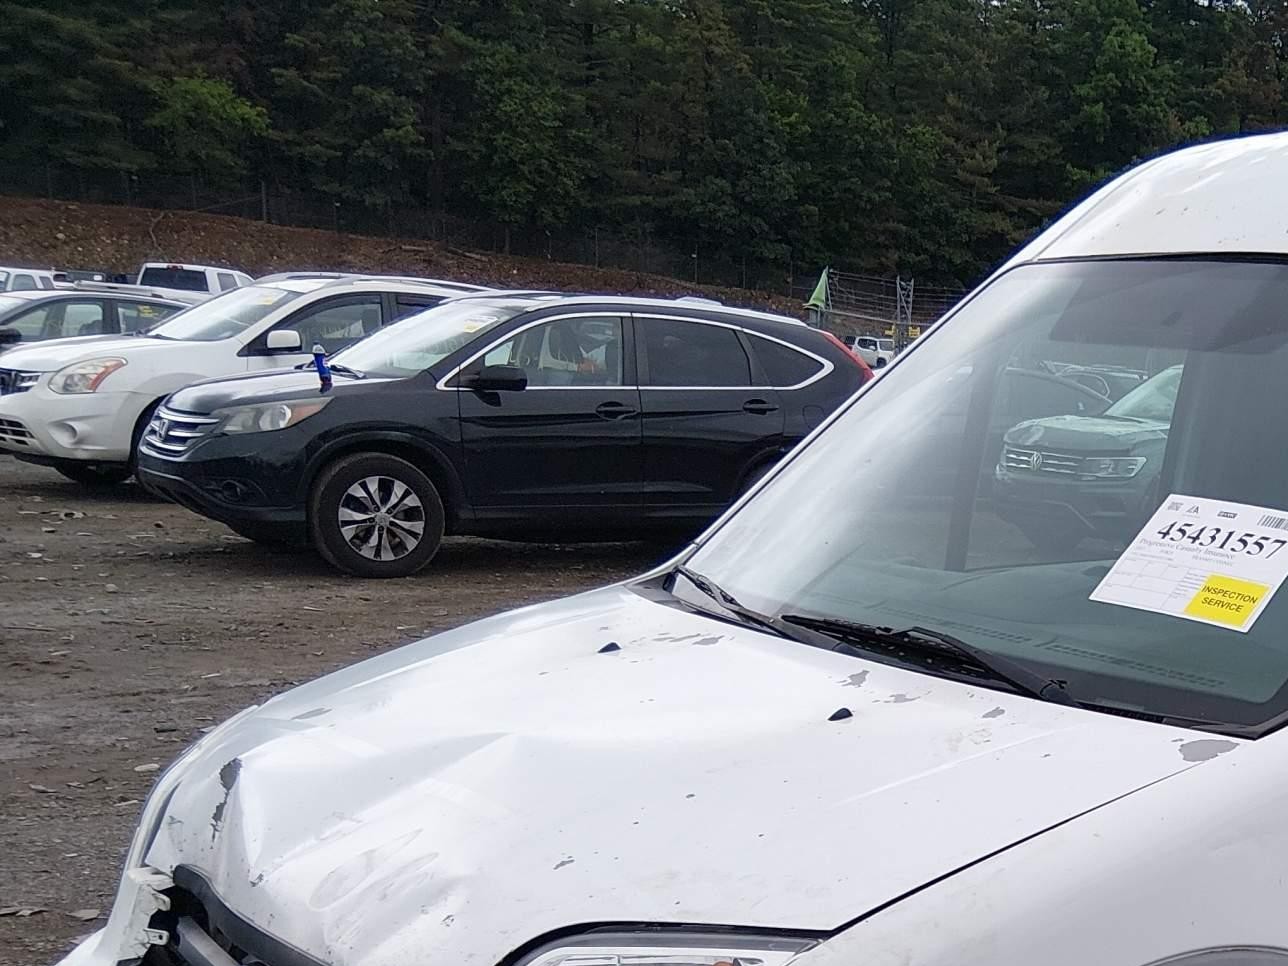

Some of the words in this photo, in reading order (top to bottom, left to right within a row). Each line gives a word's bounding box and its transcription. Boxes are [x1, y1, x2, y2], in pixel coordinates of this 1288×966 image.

[1156, 520, 1288, 560] 45431557
[1201, 597, 1244, 613] SERVICE
[1202, 584, 1259, 605] INSPECTION
